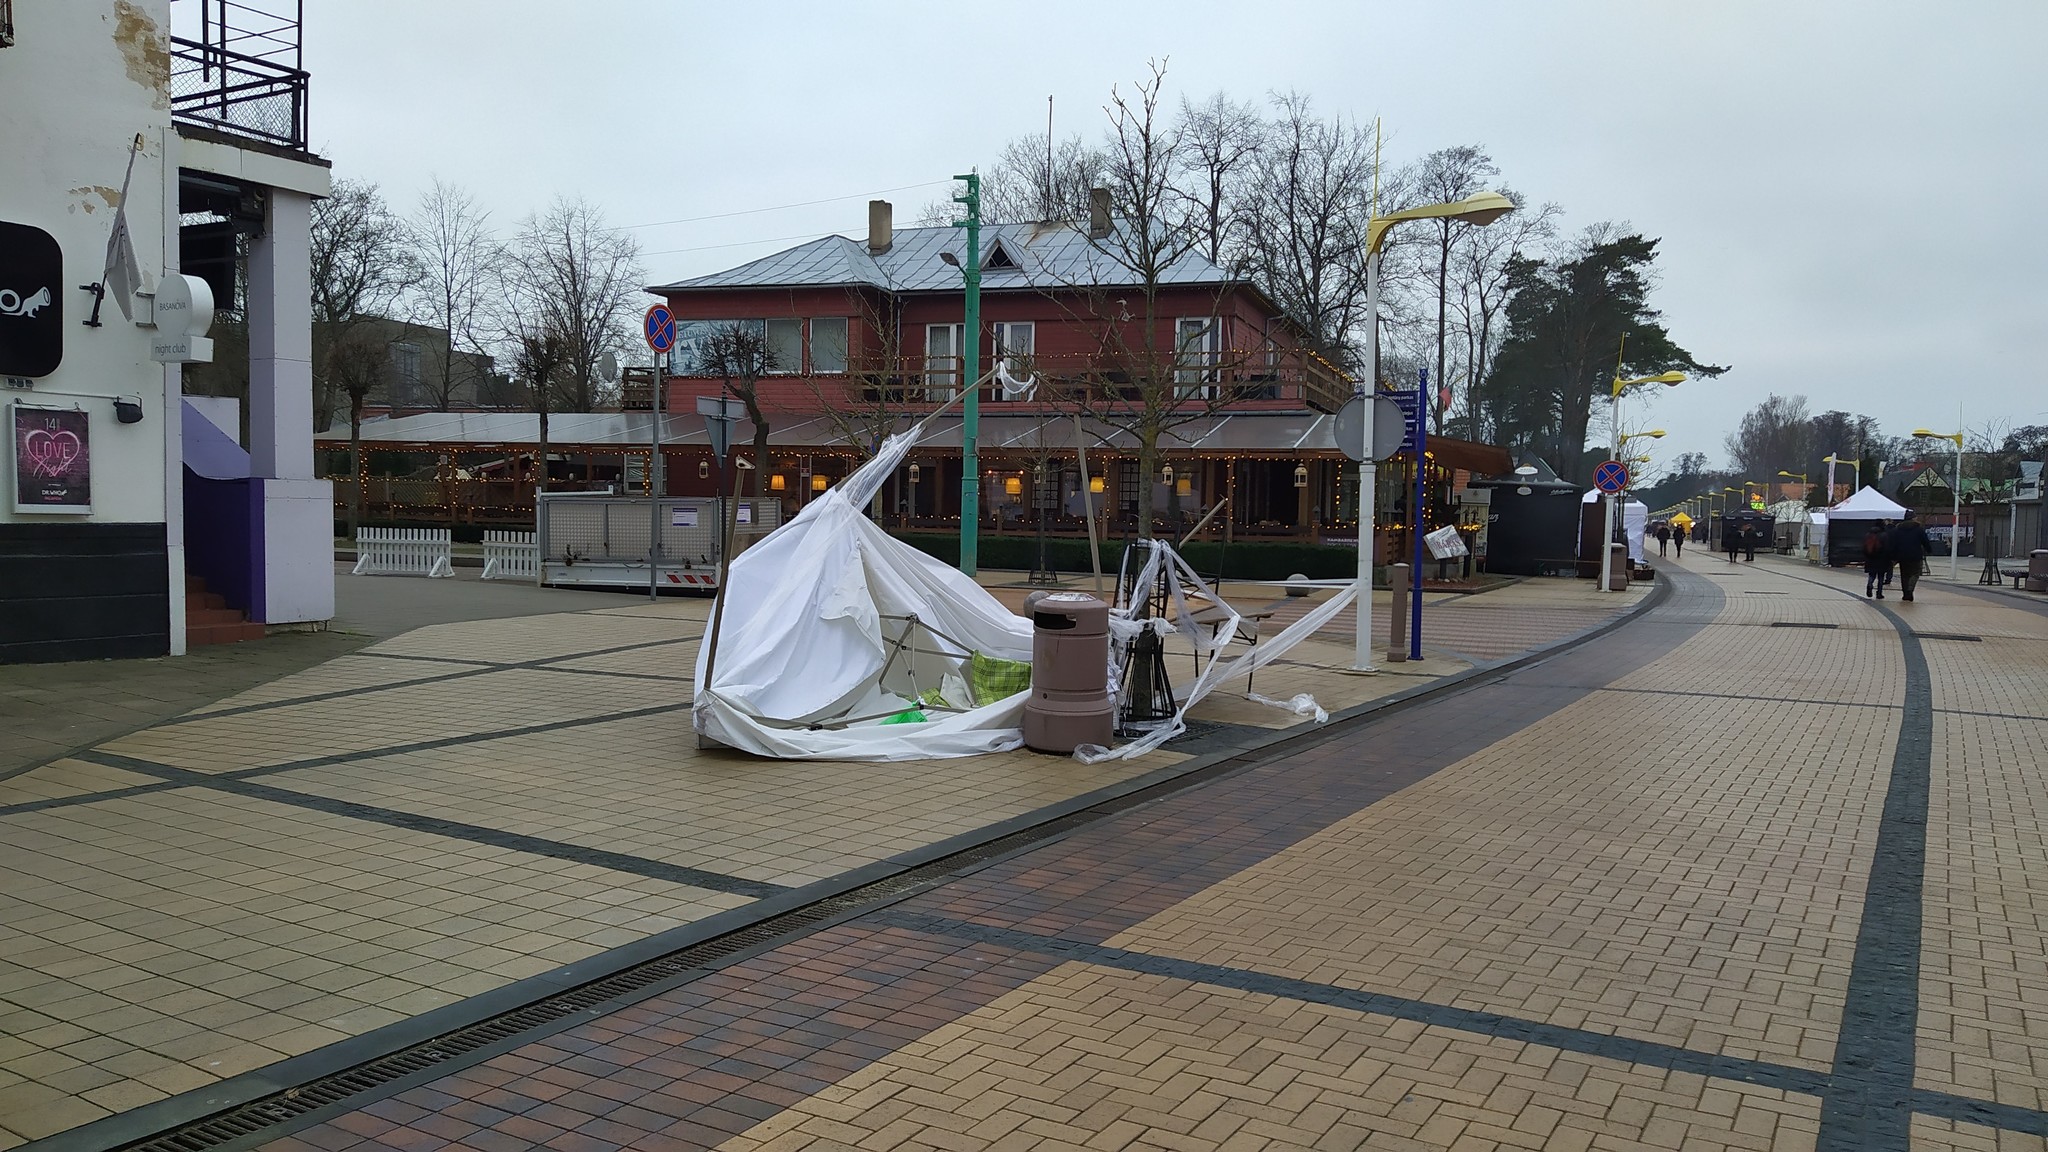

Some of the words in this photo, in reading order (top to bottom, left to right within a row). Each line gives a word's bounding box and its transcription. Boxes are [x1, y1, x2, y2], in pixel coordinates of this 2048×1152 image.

[155, 343, 172, 357] night
[172, 342, 187, 354] club
[44, 417, 56, 430] 14
[35, 441, 71, 459] LOVE
